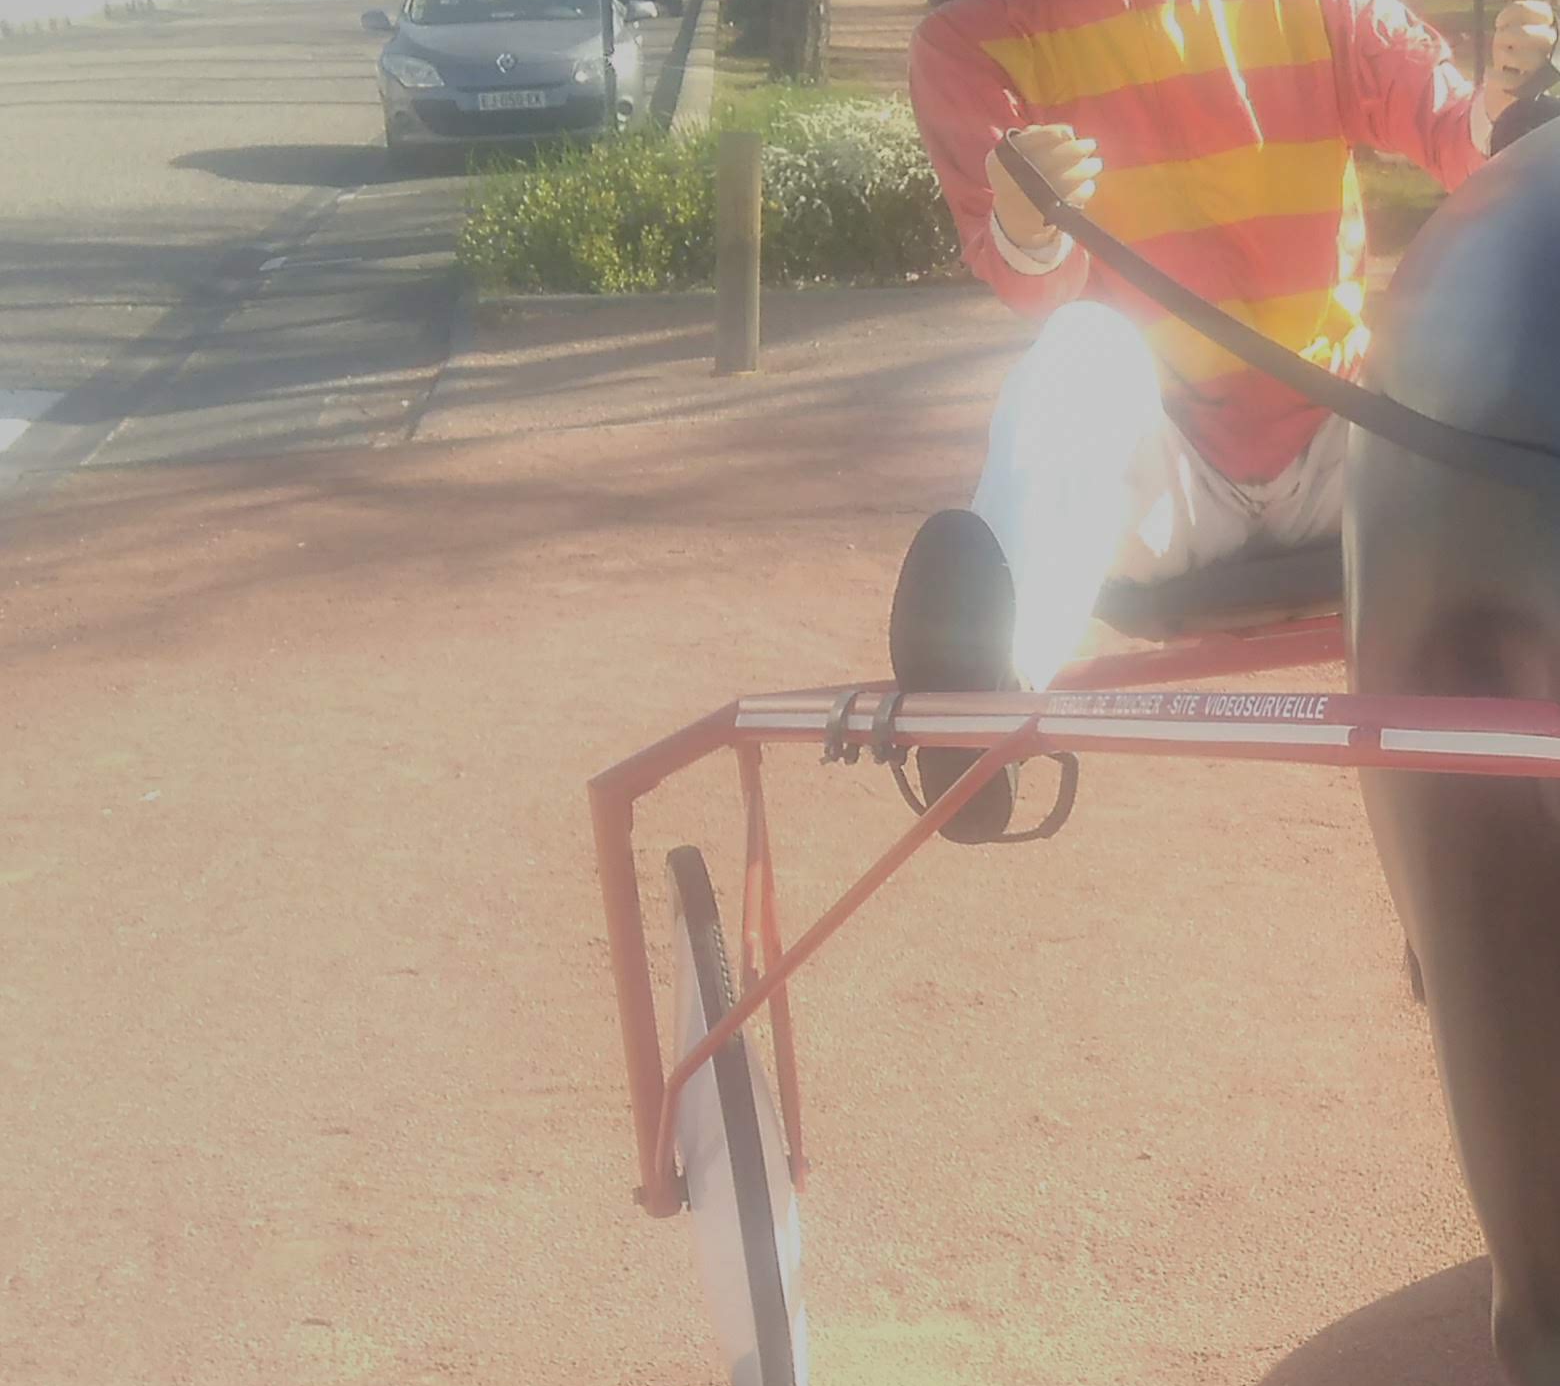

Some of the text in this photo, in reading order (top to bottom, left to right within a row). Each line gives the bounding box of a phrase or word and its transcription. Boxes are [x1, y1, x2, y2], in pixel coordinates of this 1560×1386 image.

[1092, 696, 1108, 715] DE
[1112, 695, 1164, 715] TOUCHER
[1205, 695, 1329, 720] VIDEOSURVEILLE
